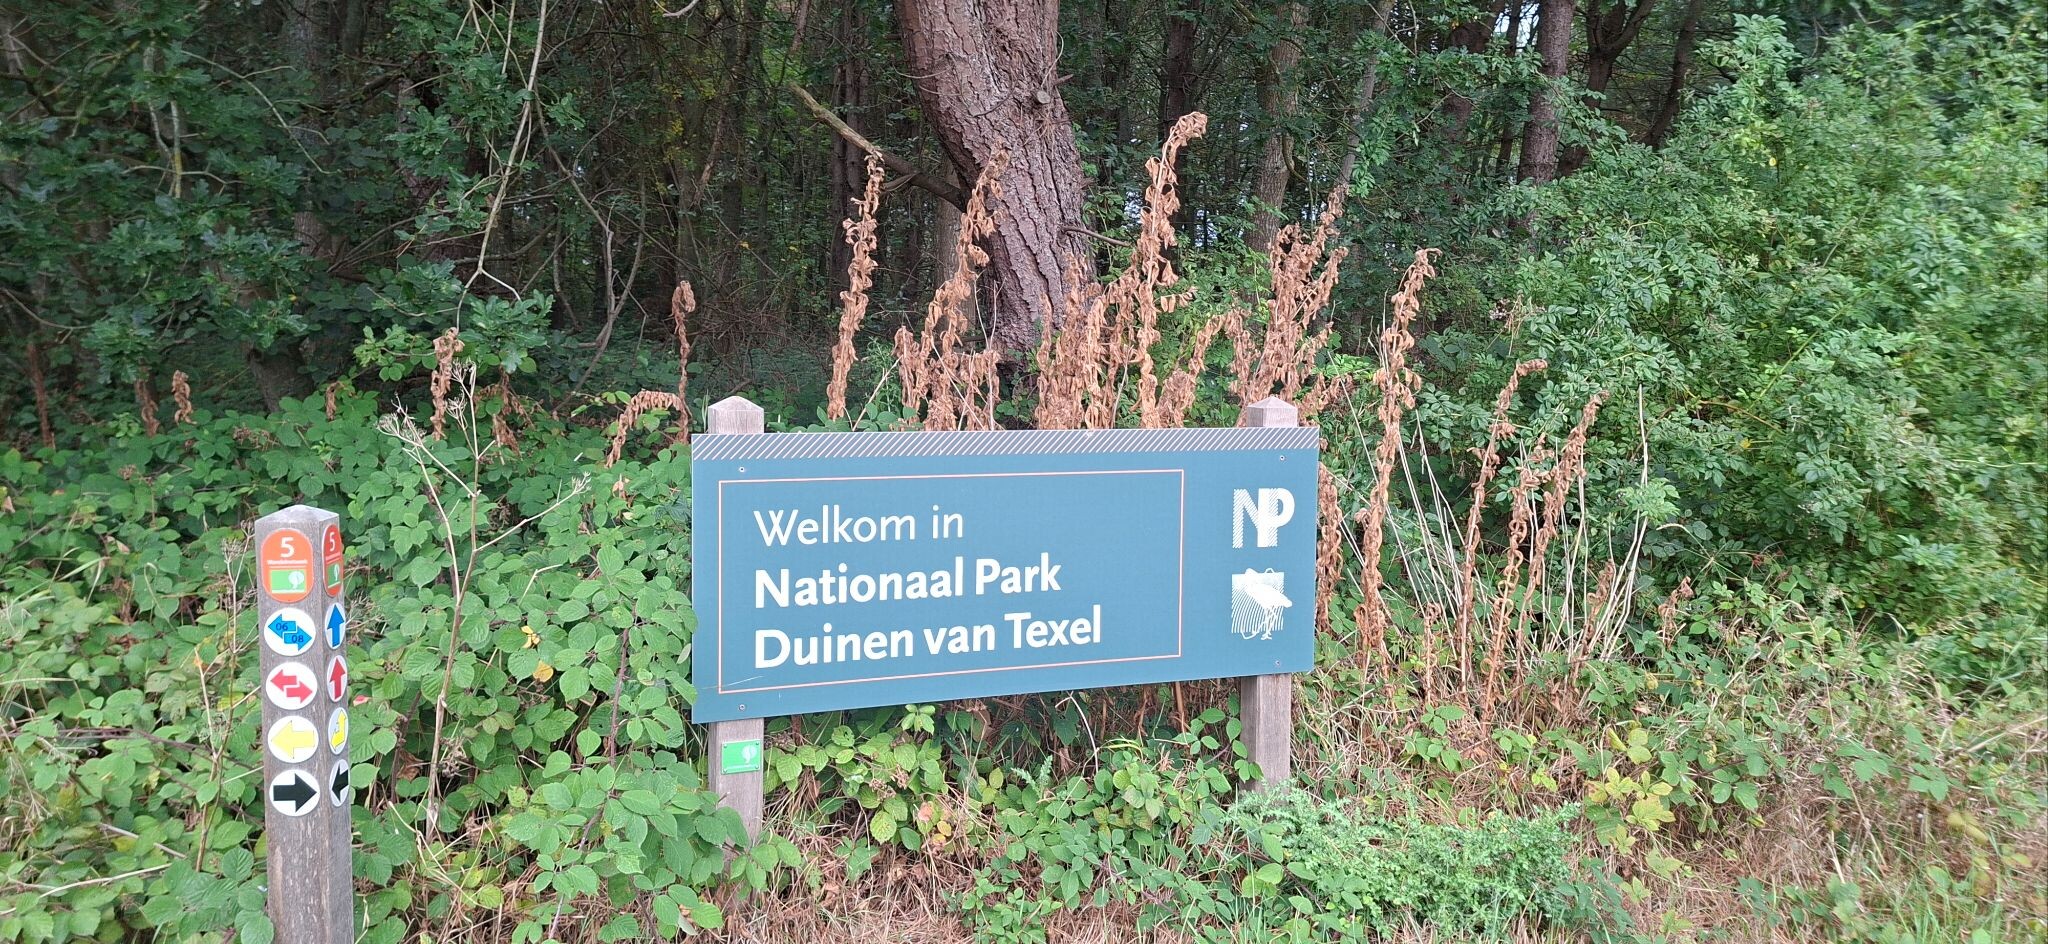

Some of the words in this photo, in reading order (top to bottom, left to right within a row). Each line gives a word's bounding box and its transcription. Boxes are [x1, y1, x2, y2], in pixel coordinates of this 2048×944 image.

[753, 504, 916, 547] Welkom
[932, 504, 964, 539] in
[1232, 487, 1296, 549] NP
[280, 536, 295, 558] 5
[329, 531, 336, 552] 5
[755, 555, 964, 609] Nationaal
[975, 551, 1062, 596] Park
[275, 622, 289, 631] 06
[291, 634, 304, 643] 08
[755, 622, 914, 669] Duinen
[923, 624, 996, 655] van
[1003, 604, 1101, 649] Texel
